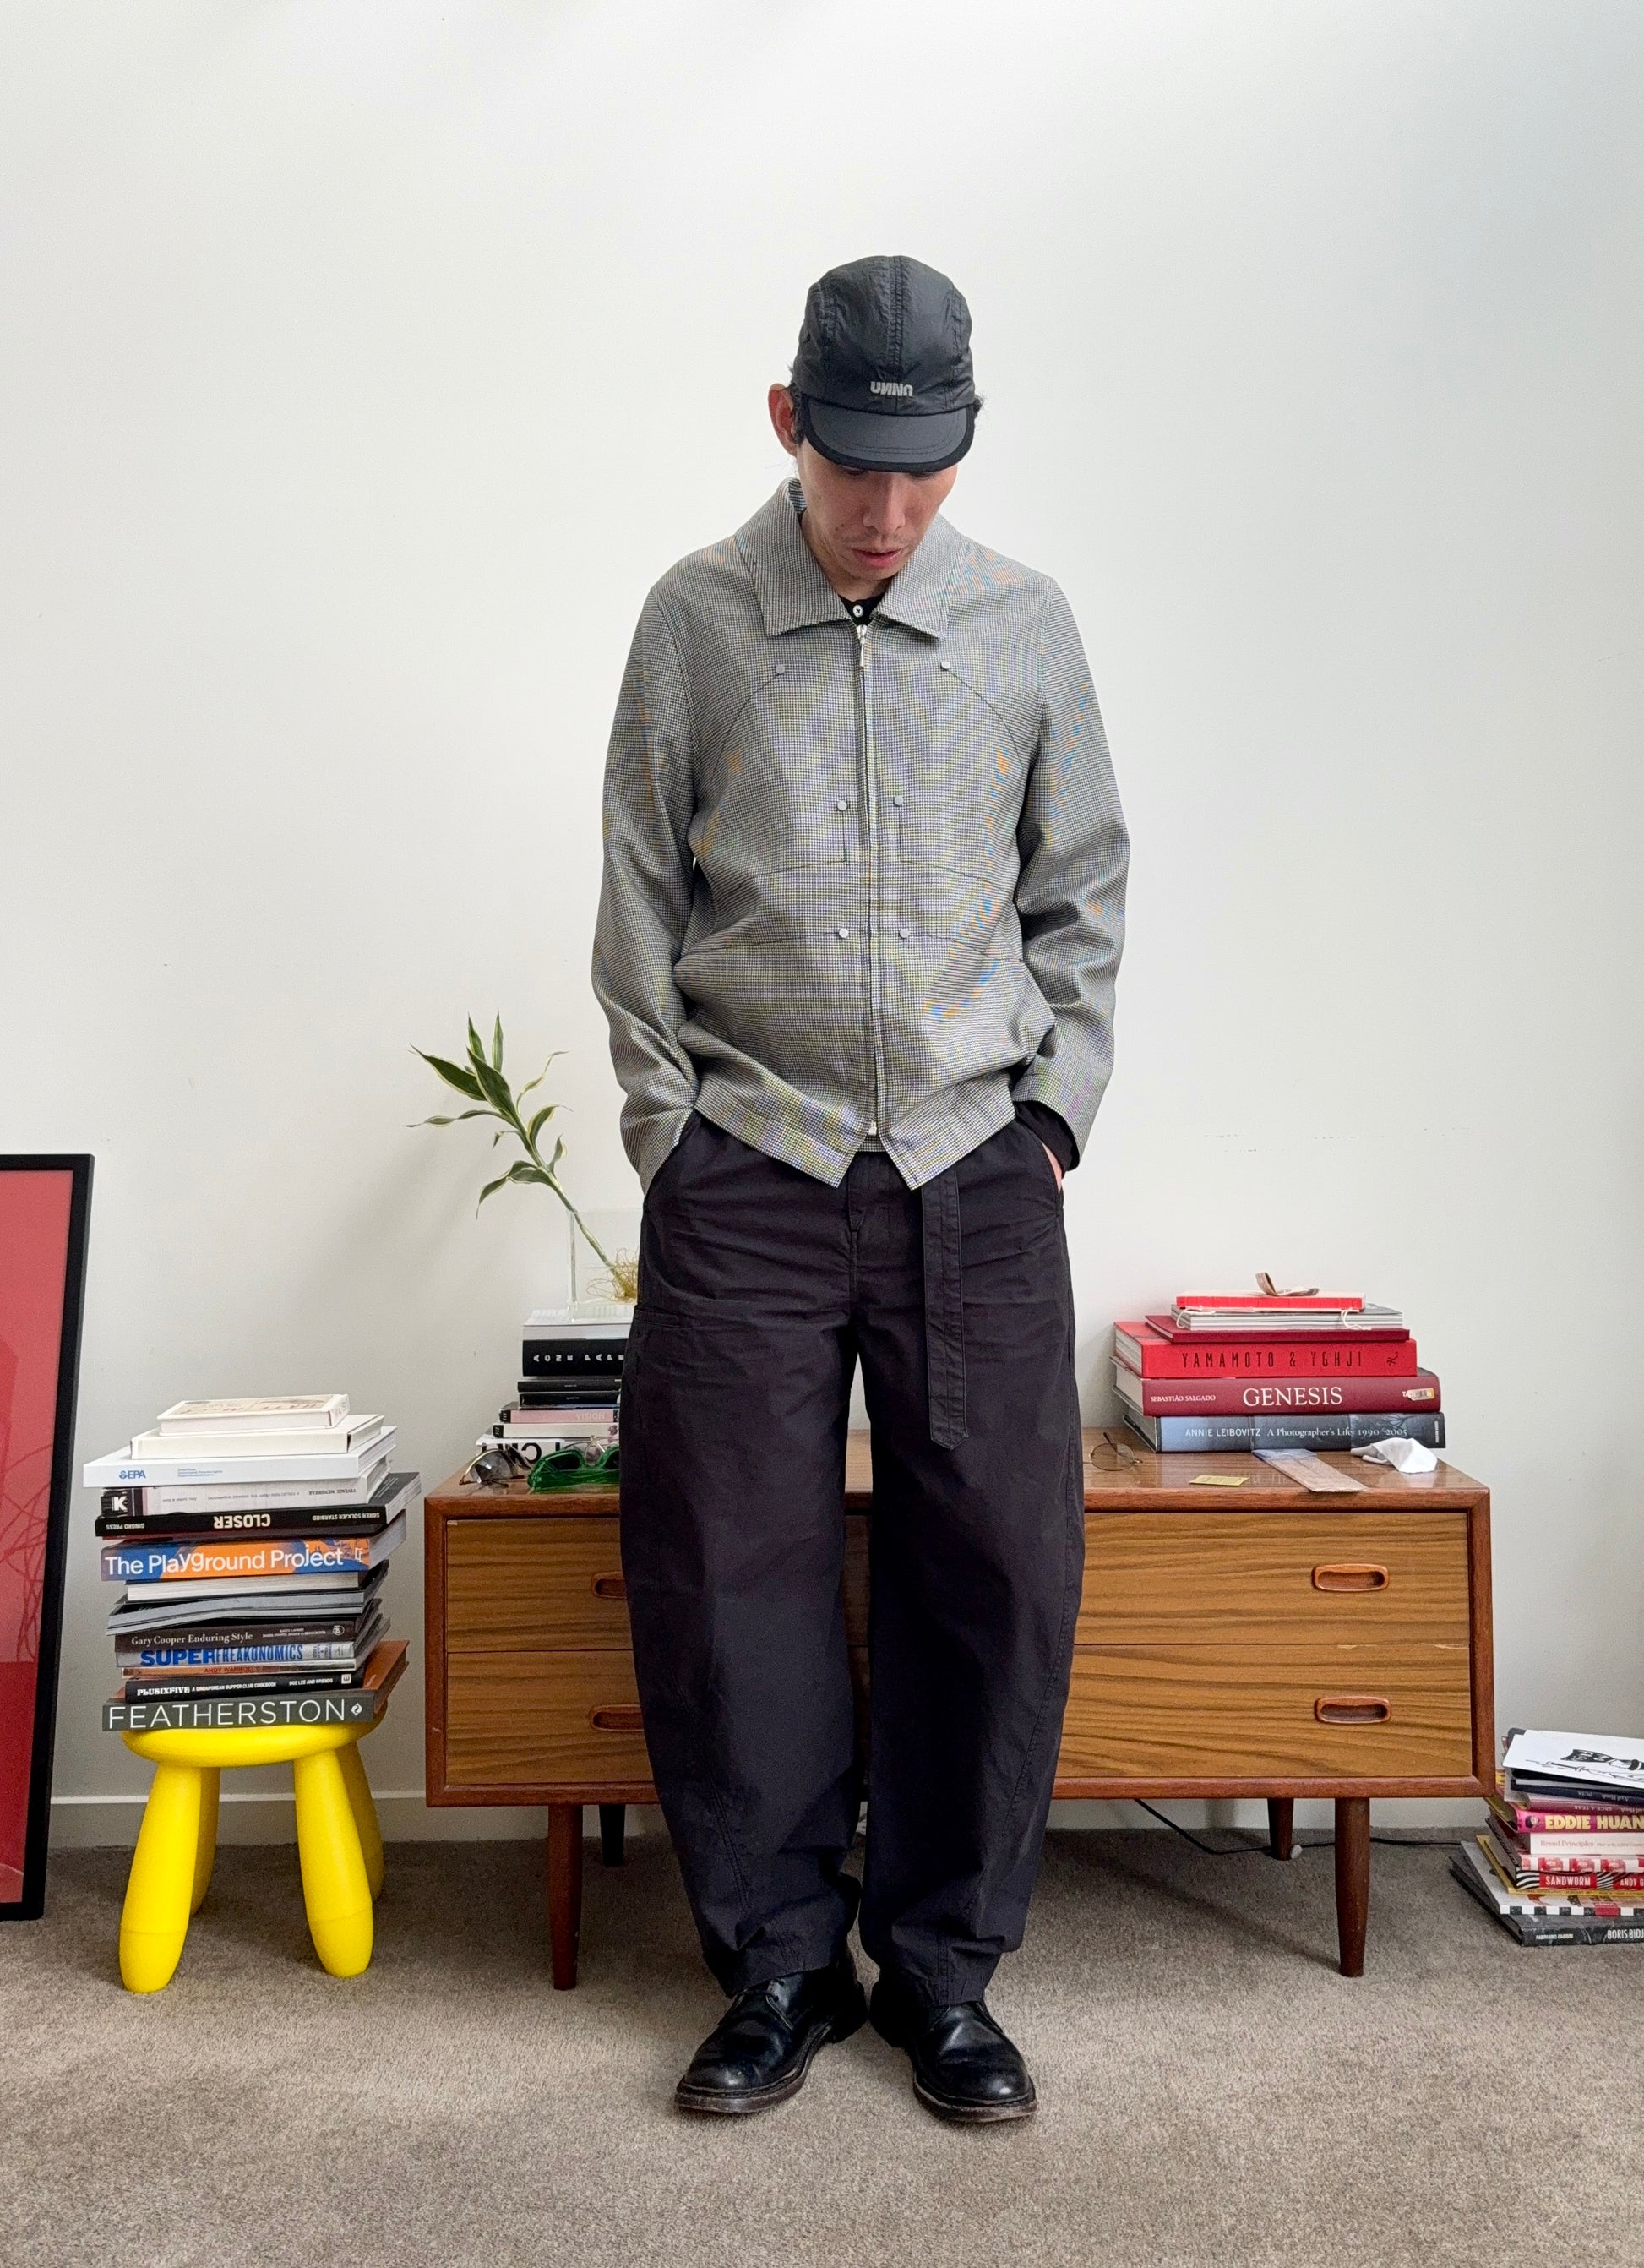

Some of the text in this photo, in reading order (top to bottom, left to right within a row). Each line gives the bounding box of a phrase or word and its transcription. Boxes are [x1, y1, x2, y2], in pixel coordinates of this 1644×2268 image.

[533, 1354, 574, 1362] ACNE
[1182, 1351, 1275, 1368] YAMAMOTO
[1289, 1351, 1297, 1368] &
[1243, 1386, 1343, 1407] GENESIS
[575, 1411, 606, 1420] VISION
[1185, 1428, 1214, 1437] ANNIE
[1217, 1428, 1261, 1437] LEIBOVITZ
[1267, 1428, 1275, 1437] A
[1277, 1427, 1335, 1438] Photographer's
[128, 1469, 146, 1480] EPA
[213, 1513, 271, 1529] CLOSER
[105, 1545, 344, 1575] The Playground Project
[131, 1636, 151, 1648] Gary
[153, 1634, 186, 1647] Cooper
[188, 1633, 230, 1644] Enduring
[231, 1632, 253, 1643] Style
[108, 1699, 345, 1729] FEATHERSTON
[1544, 1814, 1592, 1830] EDDIE
[1561, 1840, 1594, 1848] Principles
[1545, 1875, 1591, 1886] SANDWORM
[1620, 1878, 1637, 1887] ANDY
[1607, 1929, 1628, 1940] BORIS
